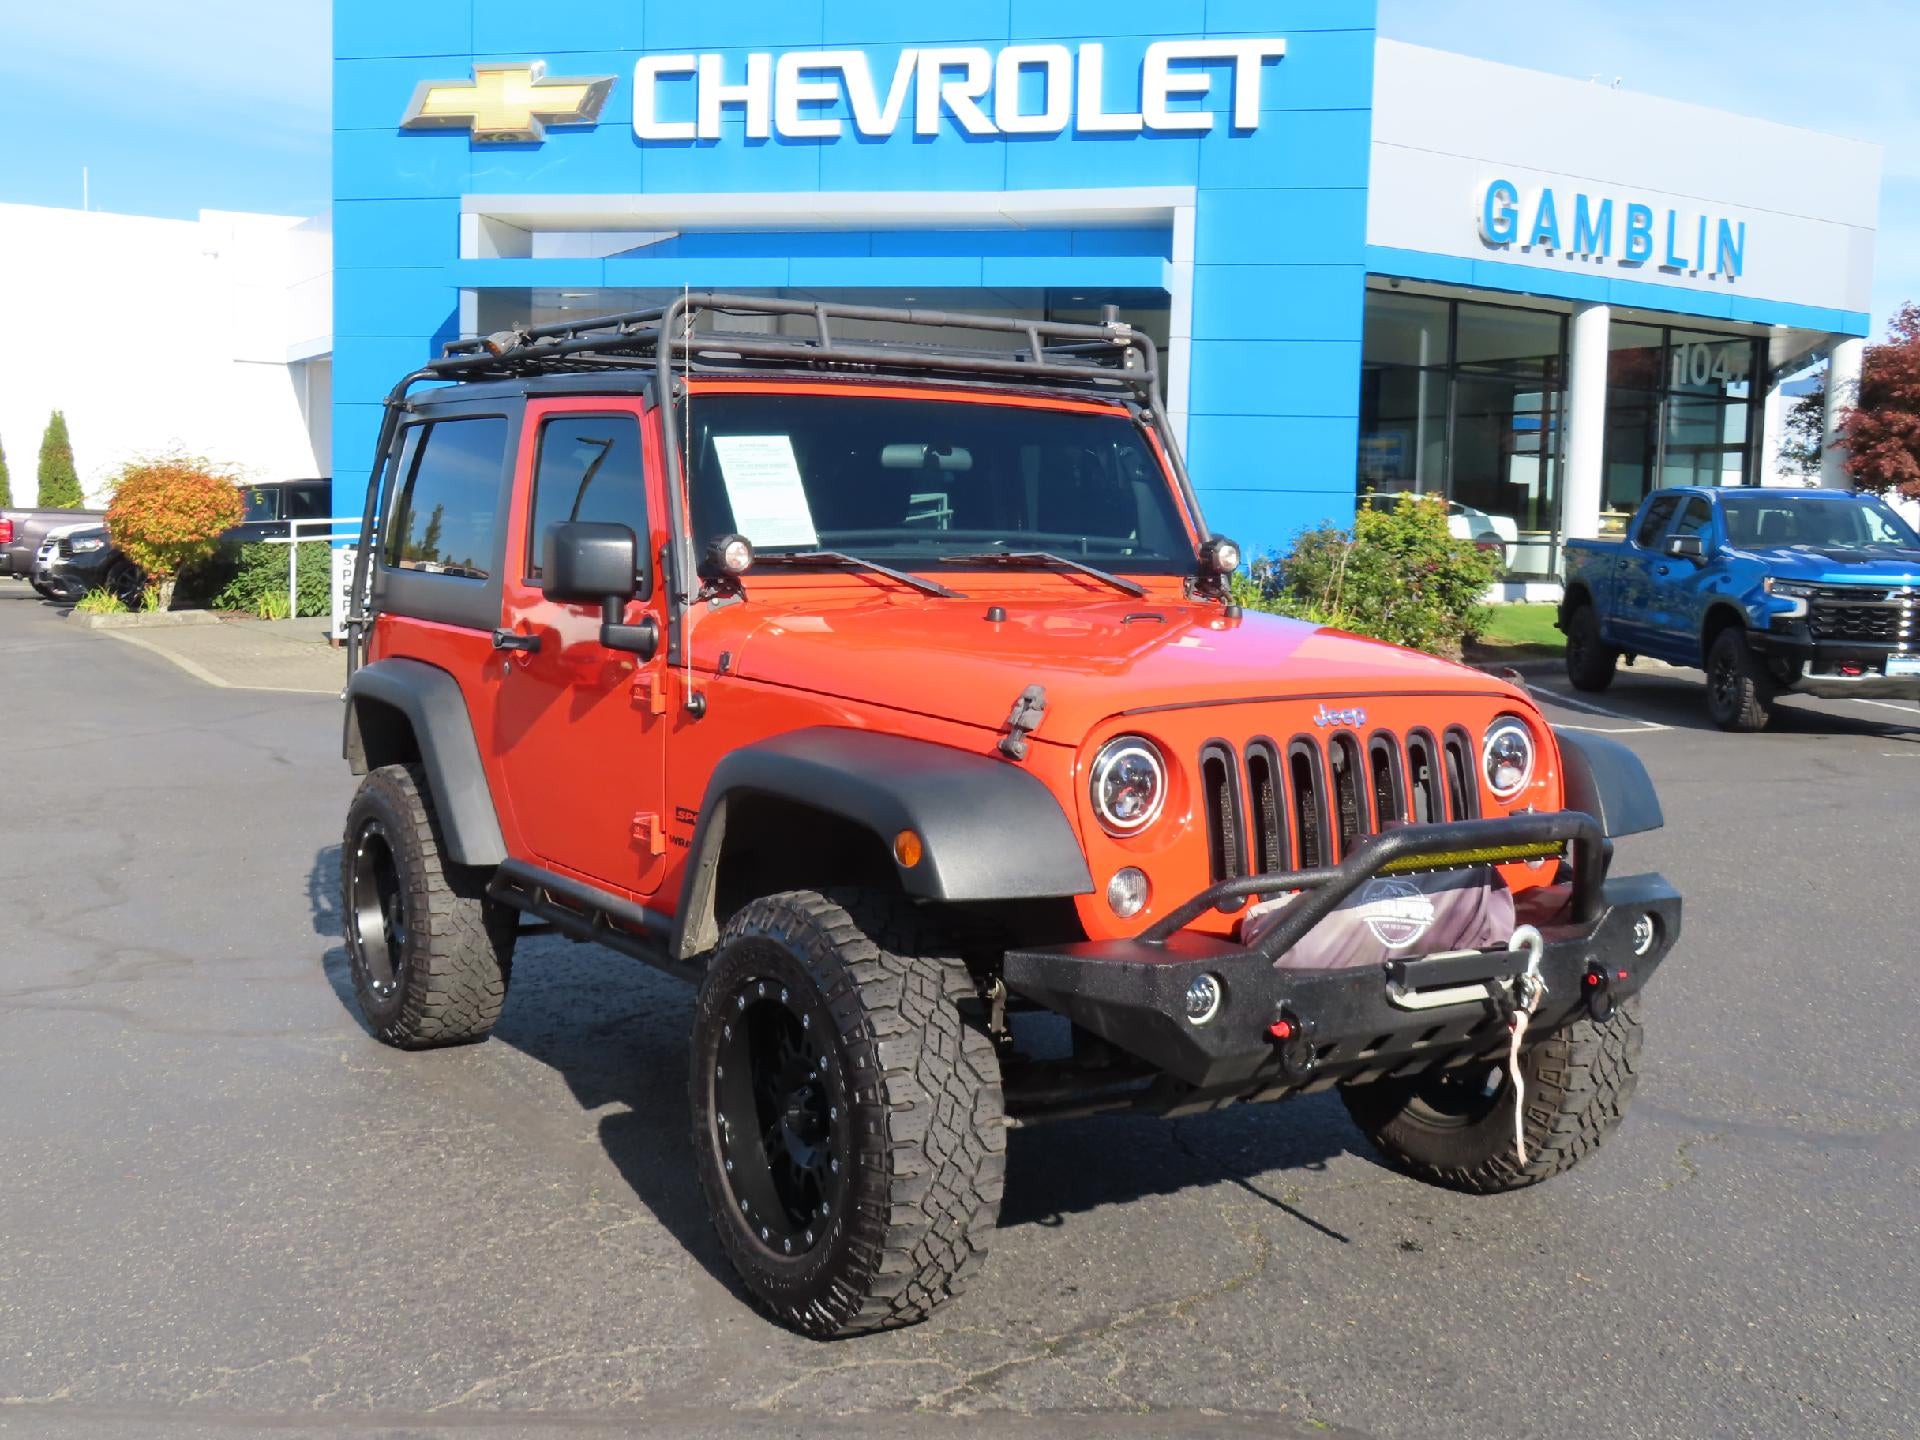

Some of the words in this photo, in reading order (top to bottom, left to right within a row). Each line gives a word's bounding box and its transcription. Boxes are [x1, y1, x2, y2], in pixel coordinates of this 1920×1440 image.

[632, 38, 1286, 140] CHEVROLET
[1482, 178, 1746, 278] GAMBLIN
[1313, 703, 1367, 729] Jeep
